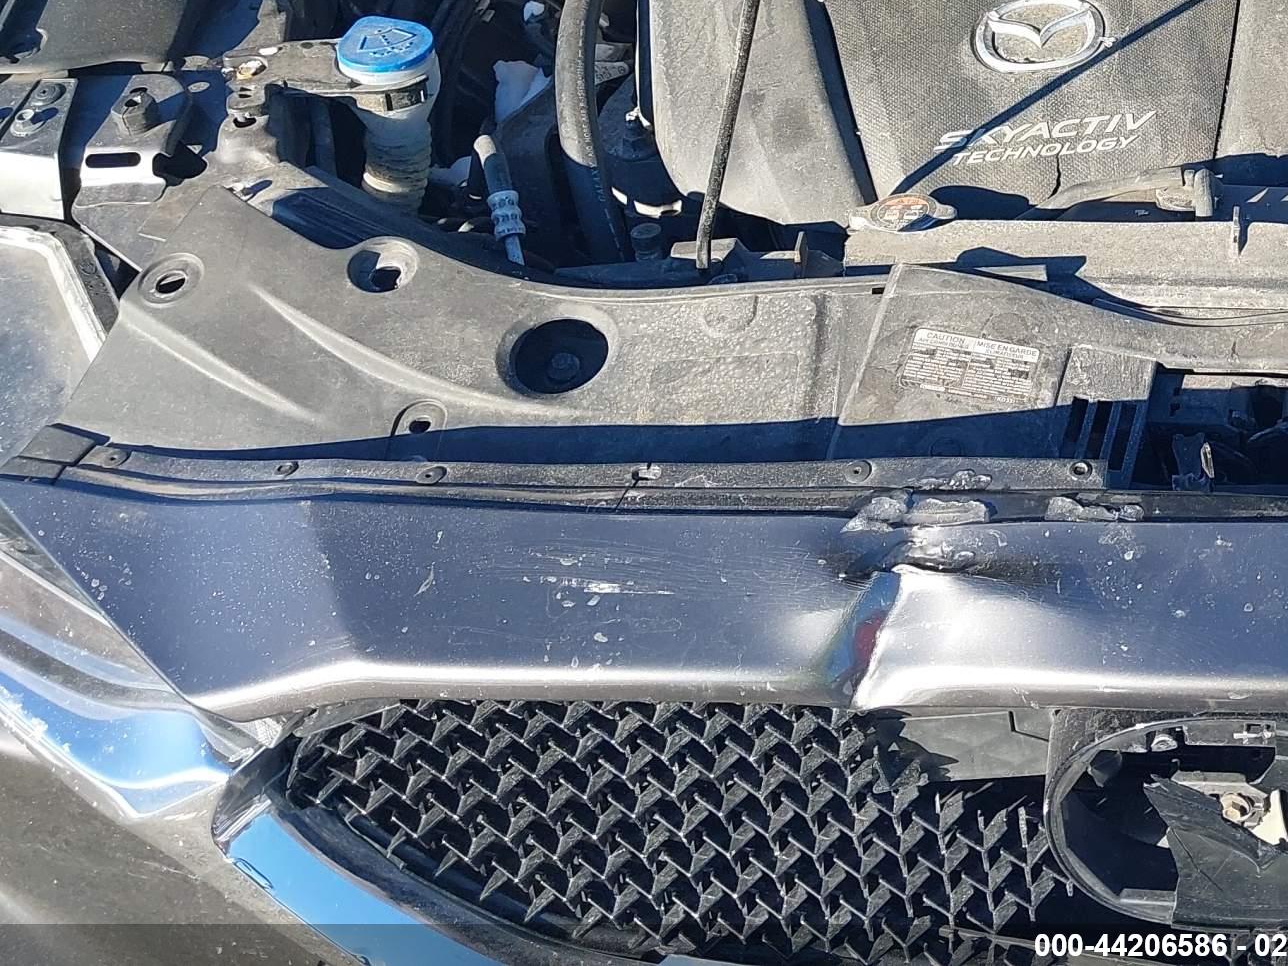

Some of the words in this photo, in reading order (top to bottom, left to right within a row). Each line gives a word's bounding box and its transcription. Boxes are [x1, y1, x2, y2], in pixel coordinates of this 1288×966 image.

[933, 110, 1157, 153] SKYACTIV
[952, 135, 1139, 166] TECHNOLOGY
[926, 332, 965, 344] CAUTION
[977, 340, 996, 350] MISE
[997, 343, 1009, 352] EN
[1009, 345, 1037, 357] GARDE
